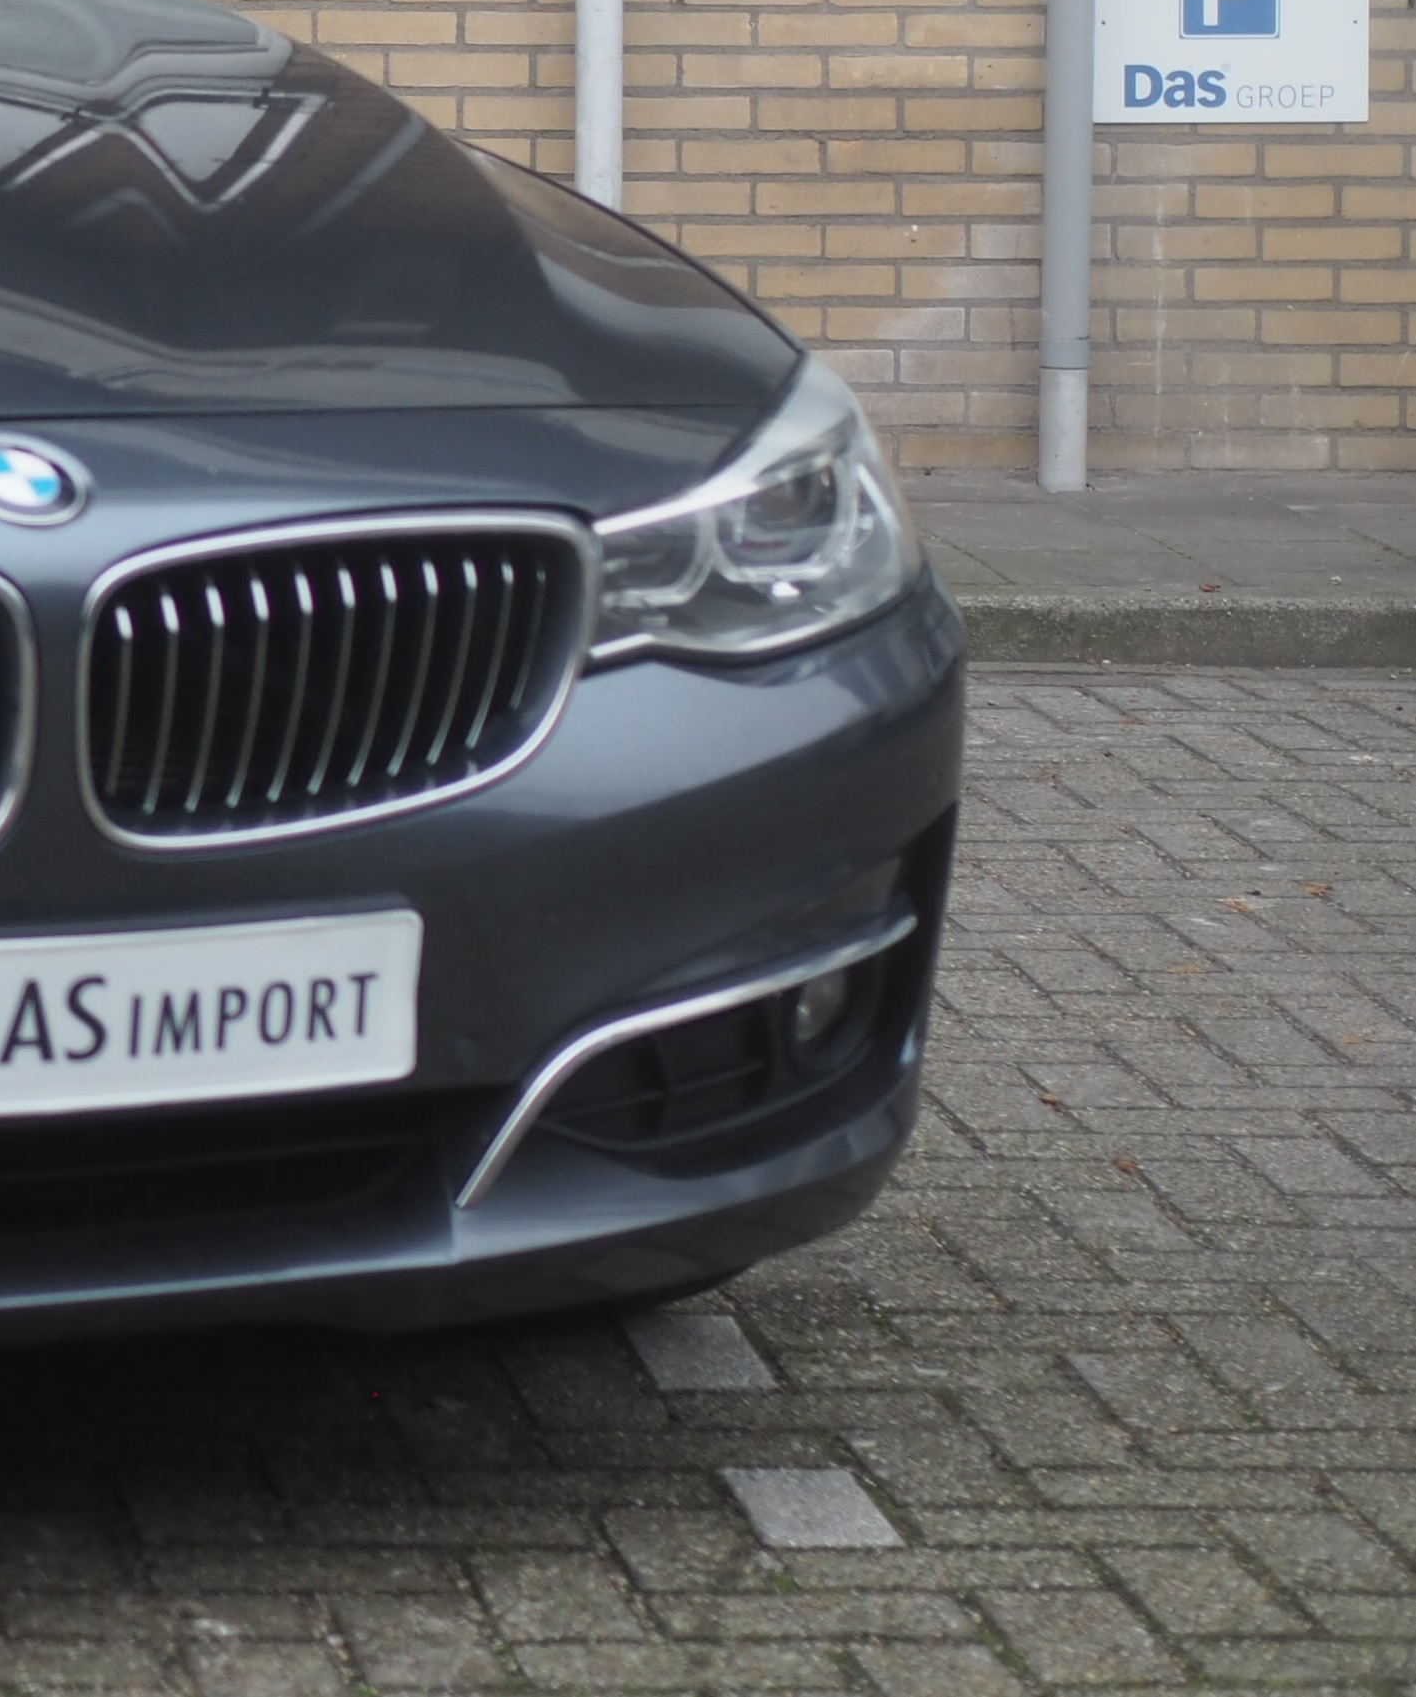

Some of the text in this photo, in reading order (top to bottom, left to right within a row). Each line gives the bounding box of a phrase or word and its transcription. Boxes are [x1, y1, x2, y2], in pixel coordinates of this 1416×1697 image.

[1124, 64, 1335, 109] Das GROEP
[127, 972, 378, 1059] IMPORT
